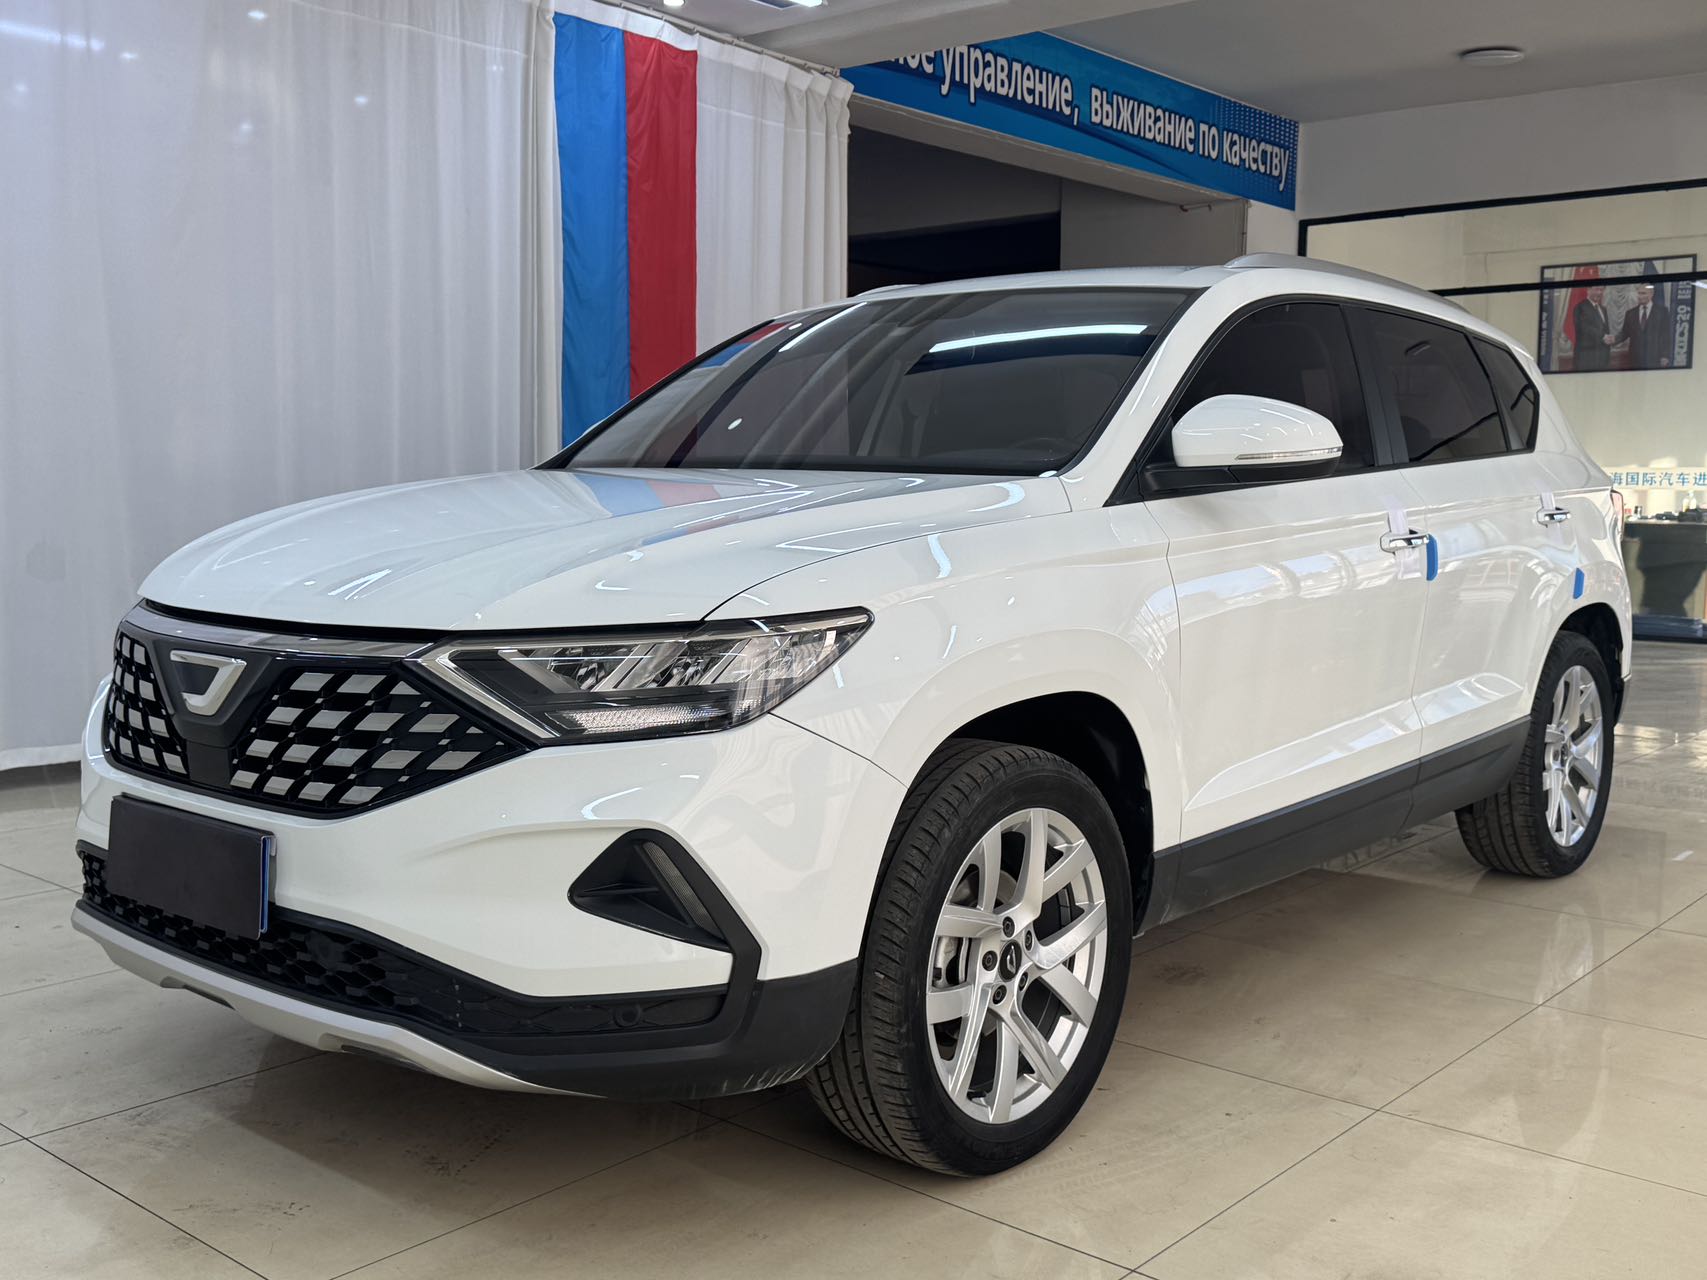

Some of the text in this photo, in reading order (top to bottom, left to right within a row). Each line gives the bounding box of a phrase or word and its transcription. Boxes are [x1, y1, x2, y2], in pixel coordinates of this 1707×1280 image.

[940, 45, 1079, 126] управление,
[1091, 86, 1195, 153] выживание
[1199, 122, 1219, 160] по
[1223, 129, 1290, 192] качеству
